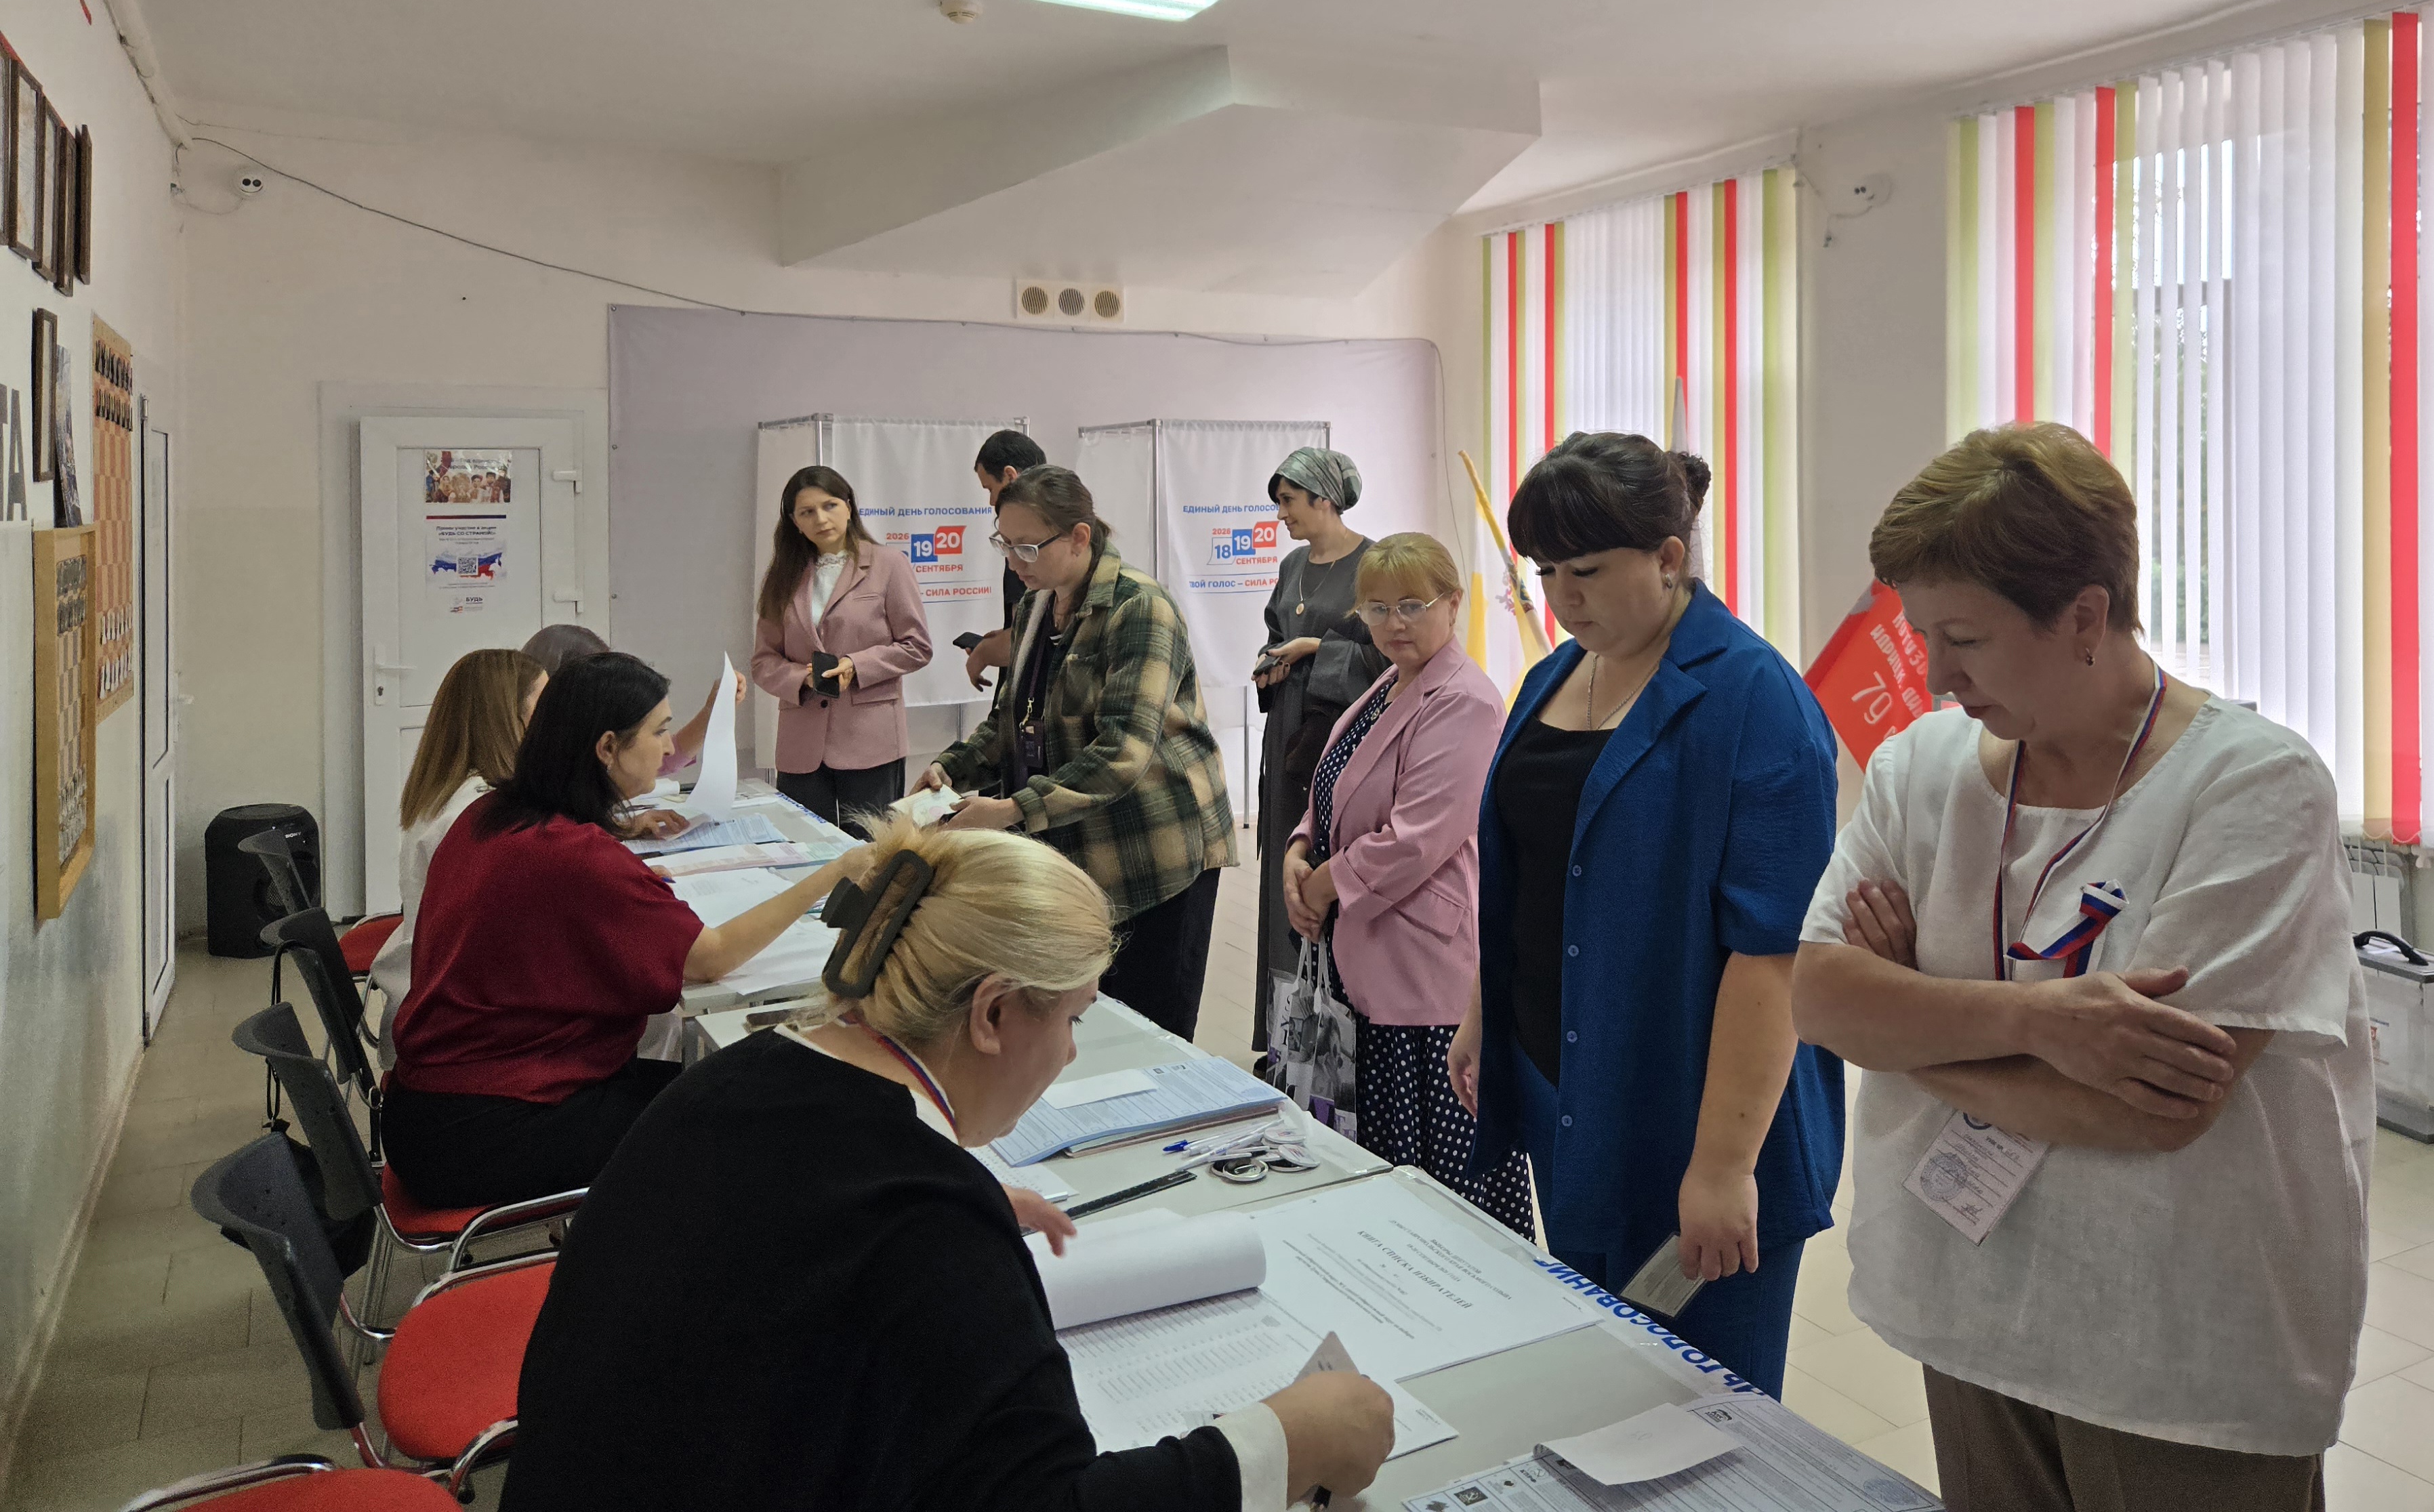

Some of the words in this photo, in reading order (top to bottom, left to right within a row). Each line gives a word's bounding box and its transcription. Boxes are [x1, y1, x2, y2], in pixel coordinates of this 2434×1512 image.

[859, 507, 896, 516] ЕДИНЫЙ
[898, 507, 922, 517] ДЕНЬ
[924, 507, 992, 516] ГОЛОСОВАНИЯ
[1183, 504, 1220, 513] ЕДИНЫЙ
[1222, 505, 1243, 514] ДЕНЬ
[886, 532, 909, 541] 2026
[913, 541, 933, 558] 19
[936, 532, 961, 549] 20
[1214, 544, 1231, 560] 18
[1234, 534, 1251, 551] 19
[1254, 527, 1275, 543] 20
[1236, 556, 1278, 566] СЕНТЯБРЯ
[915, 564, 964, 573] СЕНТЯБРЯ
[1208, 580, 1236, 588] ГОЛОС
[1244, 579, 1267, 587] СИЛА
[926, 589, 951, 597] СИЛА
[1851, 671, 1893, 725] 79
[1357, 1230, 1384, 1248] КНИГА
[1382, 1246, 1414, 1272] СПИСКА
[1411, 1269, 1474, 1309] ИЗБИРАТЕЛЕЙ
